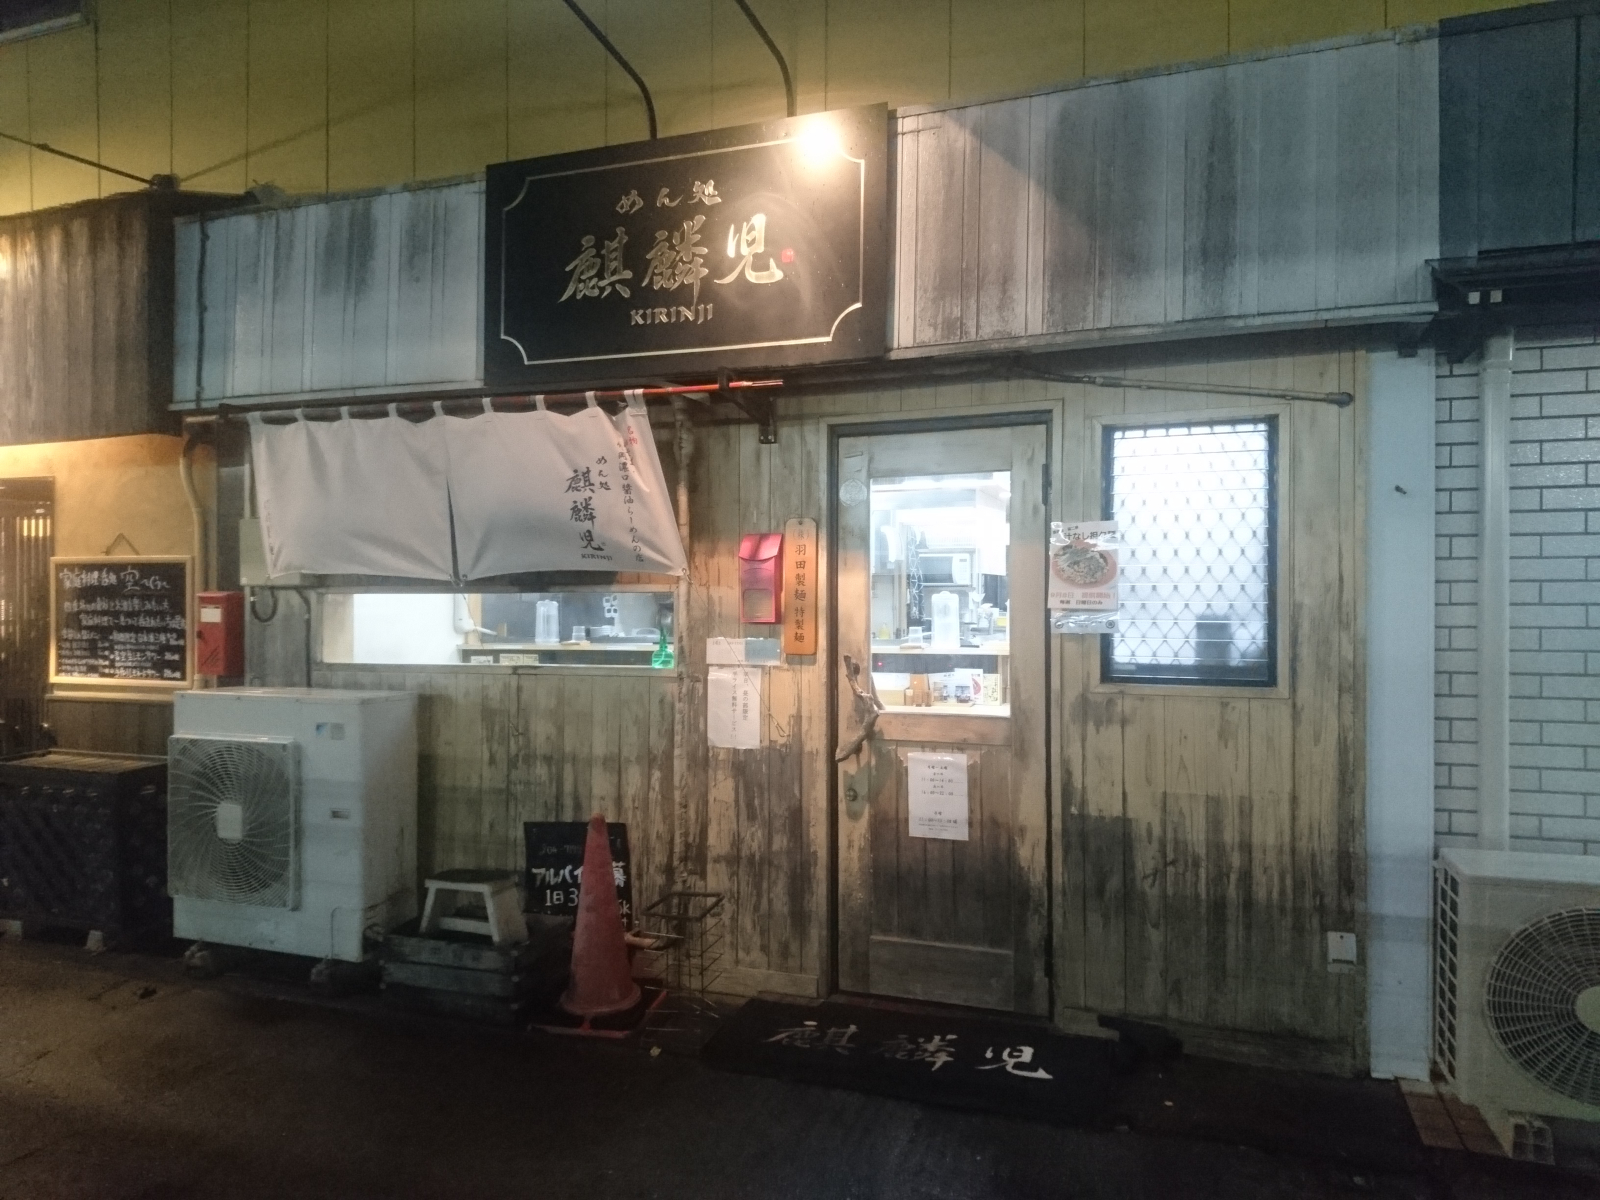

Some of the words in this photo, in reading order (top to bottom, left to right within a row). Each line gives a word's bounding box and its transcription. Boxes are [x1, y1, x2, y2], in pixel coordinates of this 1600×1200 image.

[615, 179, 722, 214] めん処
[557, 213, 784, 304] 麒麟児
[630, 303, 713, 326] KIRINJI
[595, 455, 612, 491] めん処
[564, 466, 605, 552] 麒麟児
